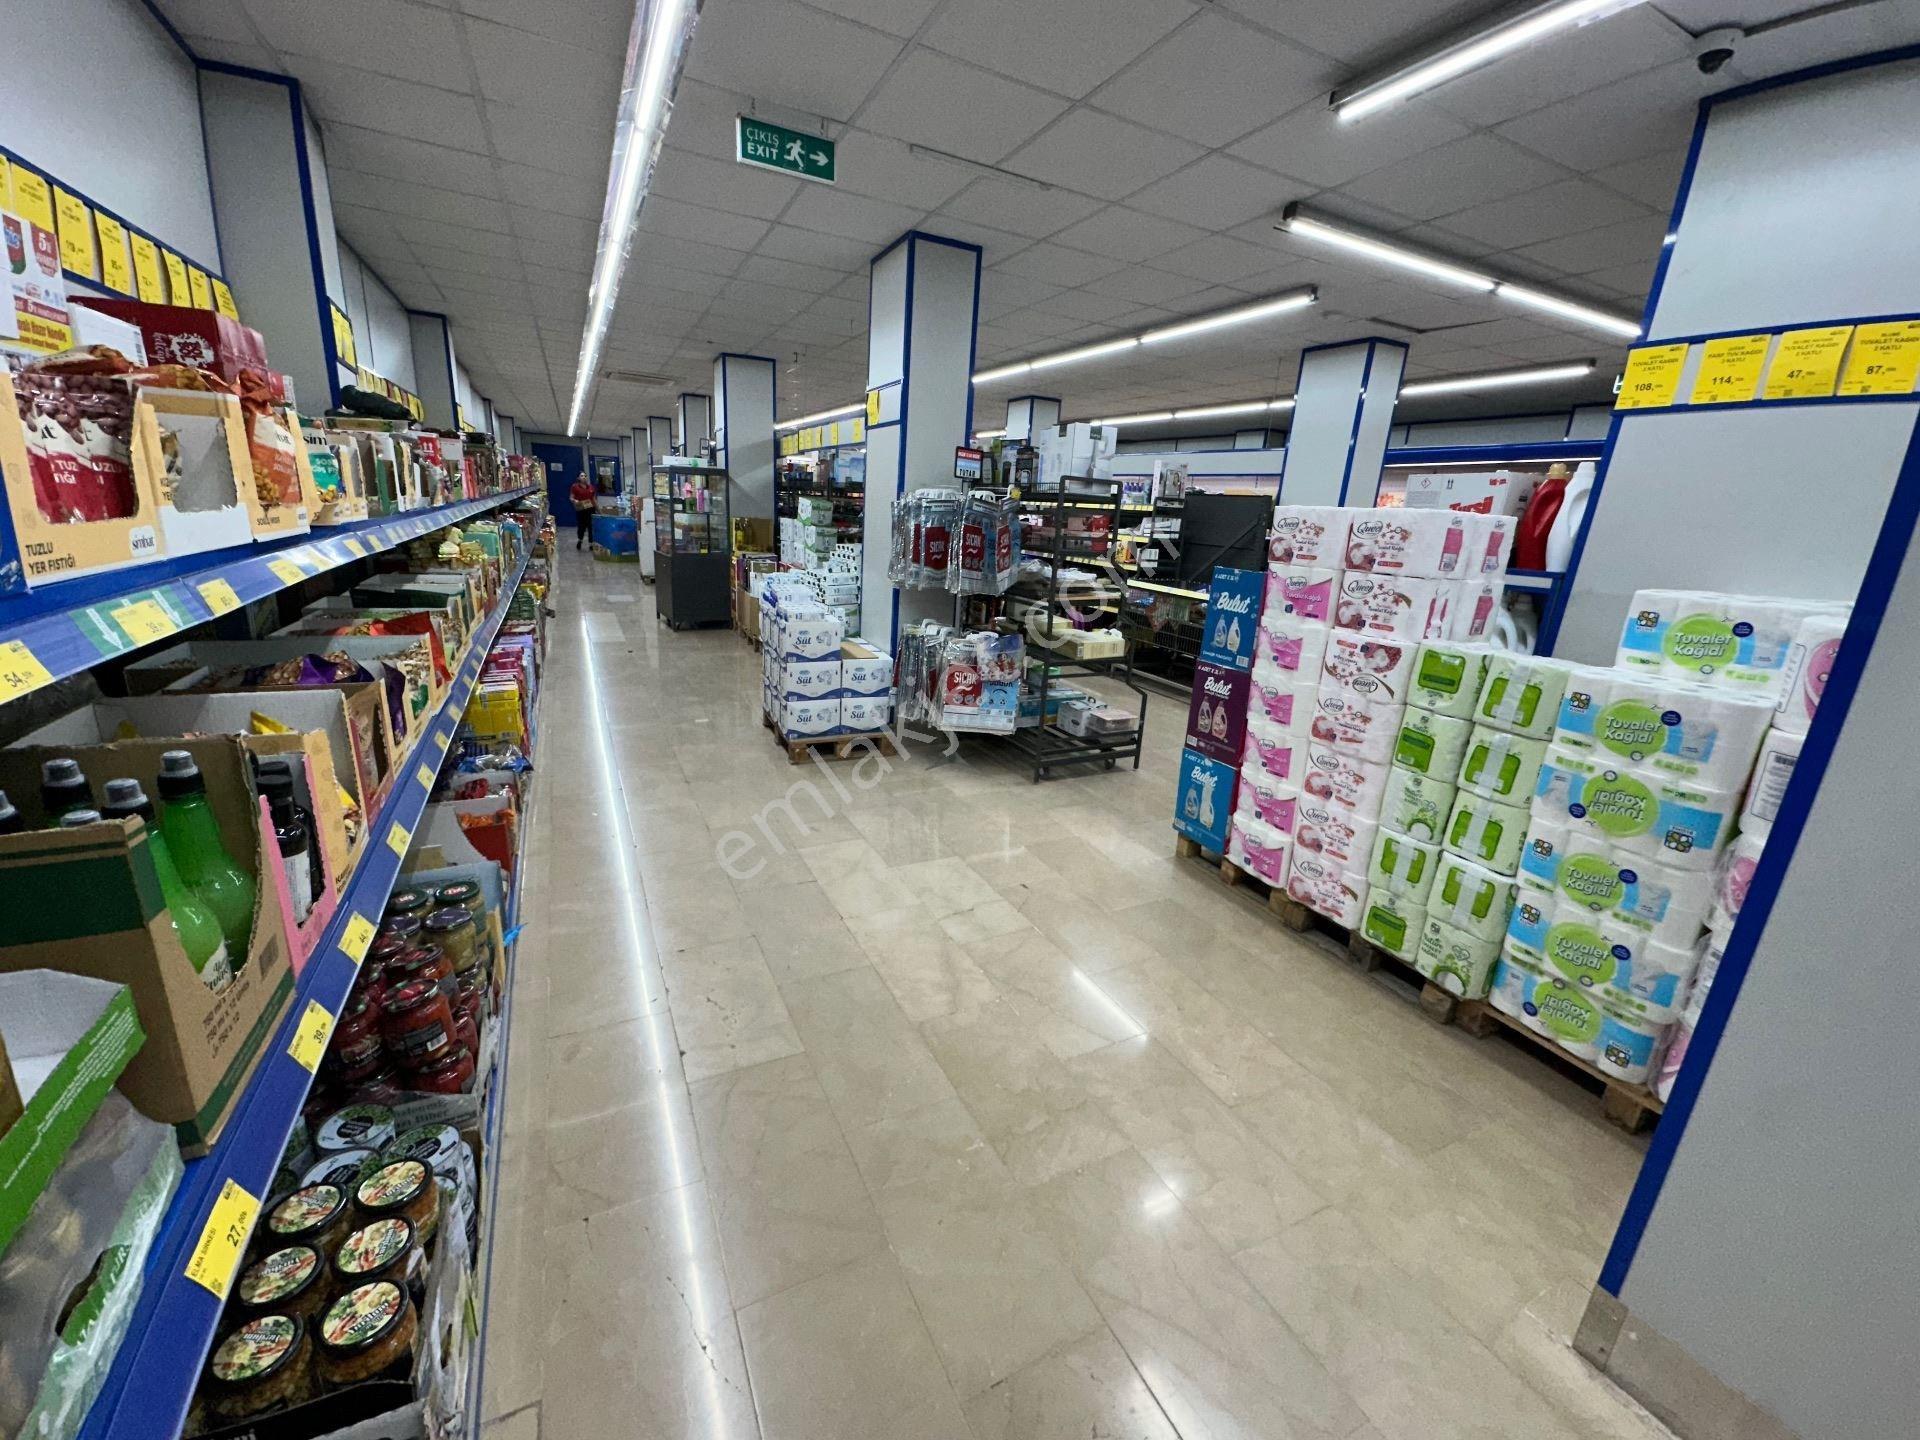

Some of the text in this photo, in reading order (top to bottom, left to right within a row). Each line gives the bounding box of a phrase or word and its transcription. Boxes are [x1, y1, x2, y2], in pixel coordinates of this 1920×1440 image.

[747, 127, 780, 147] ÇIKIŞ
[748, 142, 778, 160] EXIT
[25, 542, 54, 557] TUZLU
[29, 553, 76, 575] YER FISTIĞI
[1348, 579, 1375, 594] Queen
[1216, 591, 1251, 614] Bulut
[795, 636, 812, 645] Süt
[1674, 632, 1733, 646] Tuvalet
[1674, 645, 1725, 659] Kağıdı
[796, 676, 812, 685] Süt
[851, 672, 866, 681] Süt
[954, 671, 978, 685] SICAK
[1204, 677, 1232, 696] Bulut
[797, 714, 812, 723] Süt
[850, 711, 865, 719] Süt
[1606, 716, 1662, 732] Tuvalet
[1604, 729, 1654, 744] Kağıdı
[1191, 766, 1218, 787] Bulut
[1595, 789, 1647, 806] Kağıdı
[1306, 808, 1329, 823] Queen
[1587, 801, 1645, 822] Tuvalet
[1300, 861, 1323, 877] Queen
[1567, 866, 1619, 887] Tuvalet
[1565, 878, 1612, 897] Kağıdı
[1556, 935, 1610, 960] Tuvalet
[1555, 946, 1602, 970] Kağıdı
[1545, 993, 1591, 1018] Kağıdı
[1540, 1005, 1589, 1032] Tuvalet
[190, 1256, 204, 1277] ELMA
